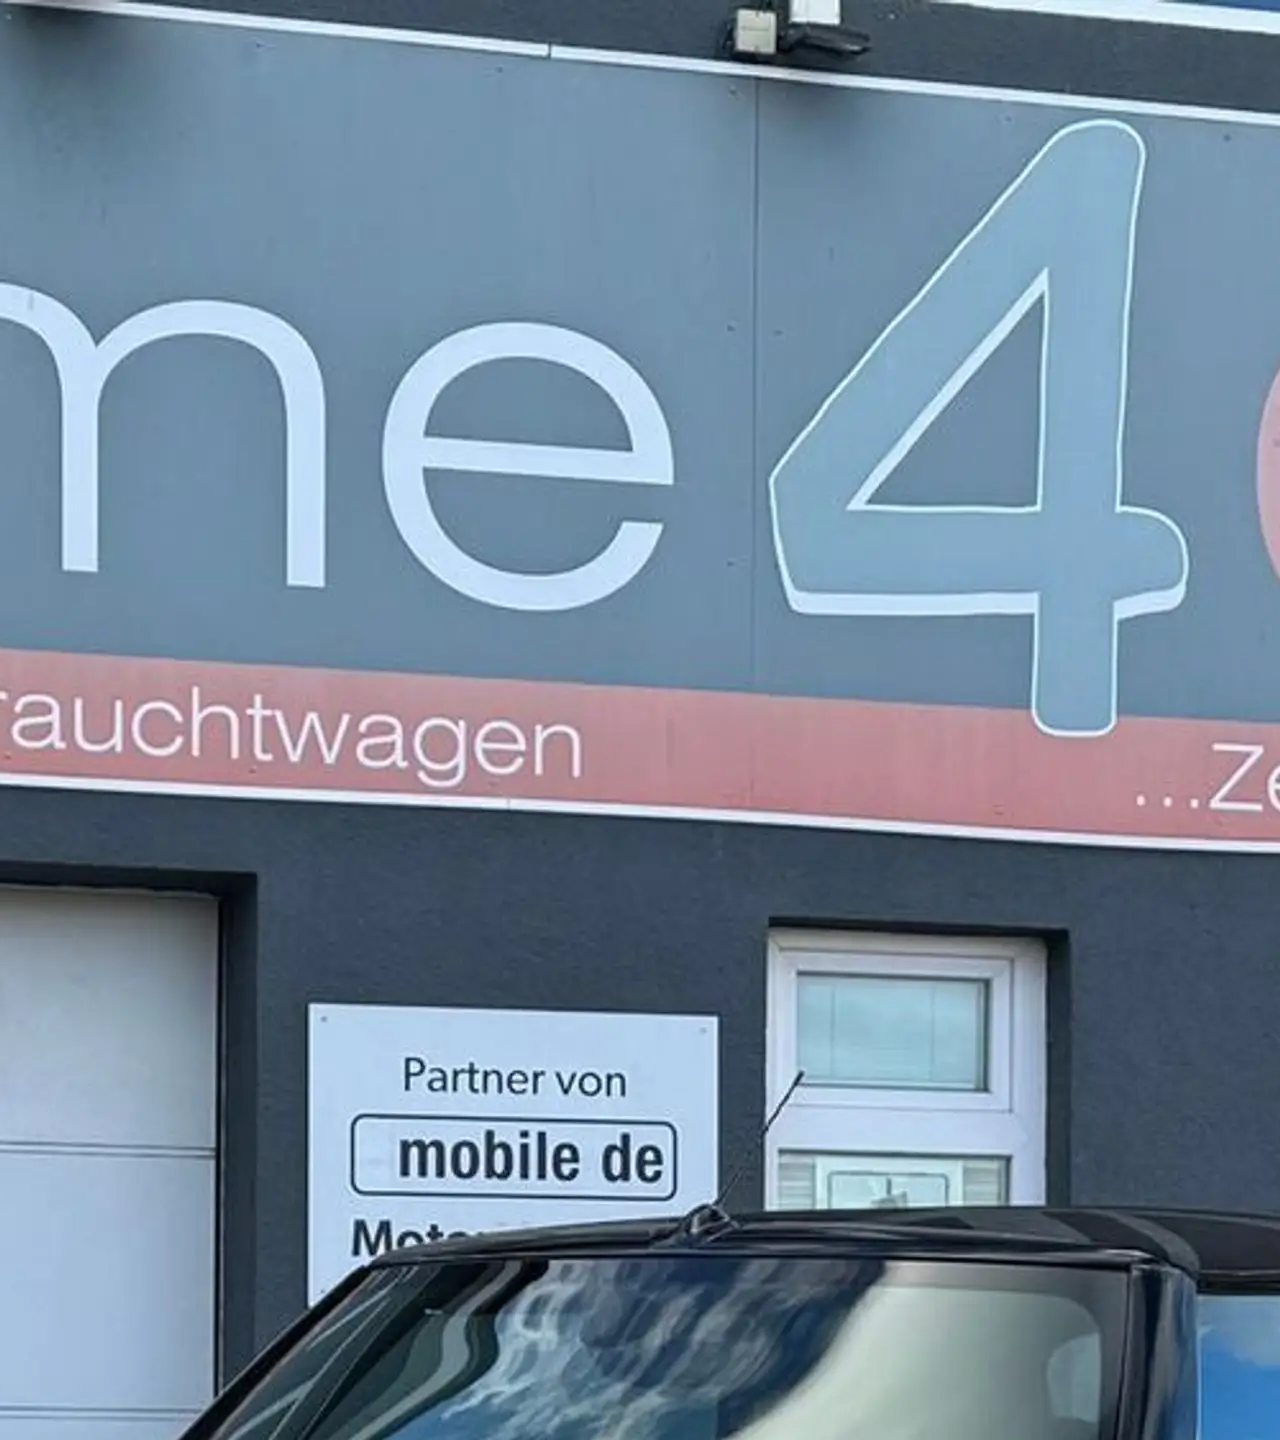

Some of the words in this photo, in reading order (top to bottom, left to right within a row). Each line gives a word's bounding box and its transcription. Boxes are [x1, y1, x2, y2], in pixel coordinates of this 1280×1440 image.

[769, 119, 1189, 738] 4
[404, 1057, 545, 1096] Partner
[556, 1072, 627, 1097] von
[399, 1130, 581, 1182] mobile
[602, 1133, 664, 1184] de
